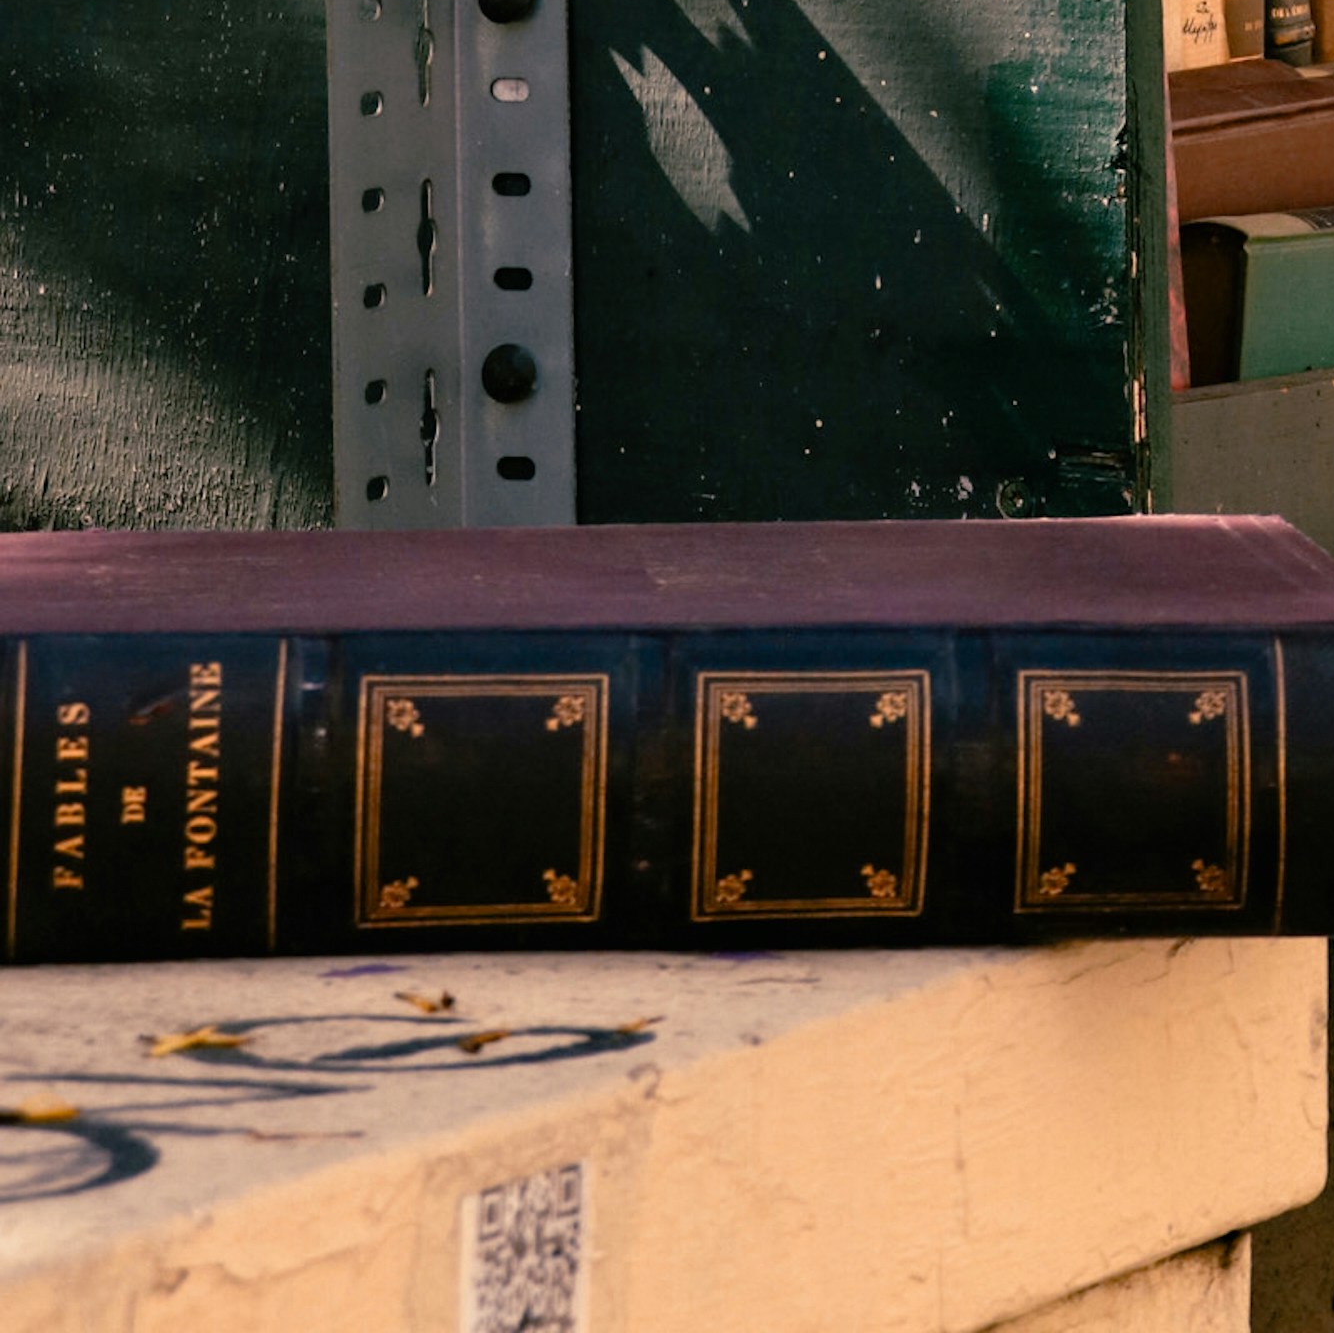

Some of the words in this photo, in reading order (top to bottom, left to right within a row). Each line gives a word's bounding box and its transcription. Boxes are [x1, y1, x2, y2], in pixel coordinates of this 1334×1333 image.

[53, 702, 91, 890] FABLES
[121, 786, 147, 824] DE
[184, 661, 222, 871] FONTAINE
[181, 885, 214, 931] LA
